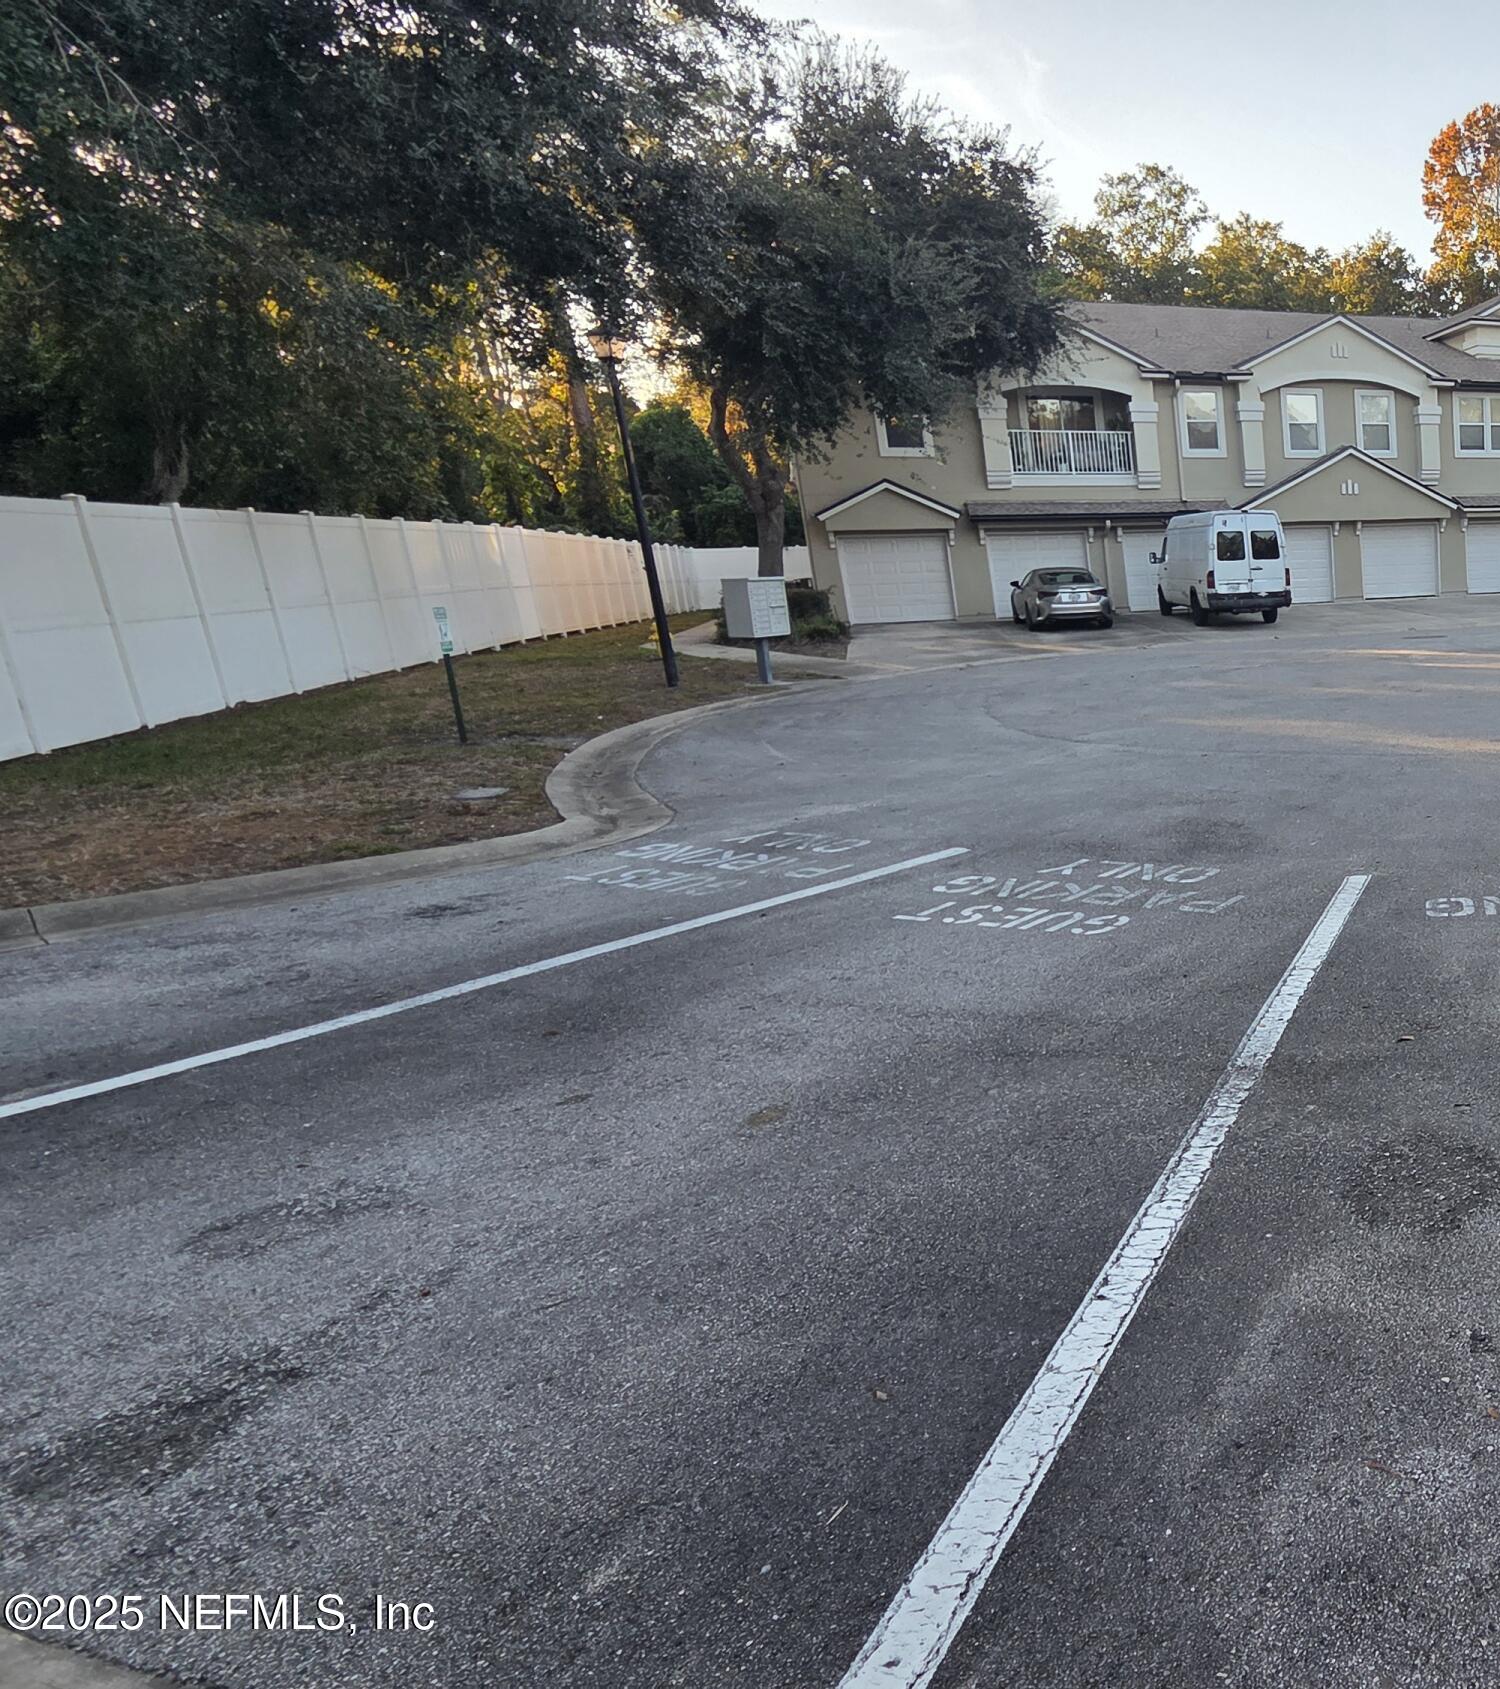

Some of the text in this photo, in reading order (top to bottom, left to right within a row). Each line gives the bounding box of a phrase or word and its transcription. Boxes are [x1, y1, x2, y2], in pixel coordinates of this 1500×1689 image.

[1037, 859, 1221, 882] ONLY
[932, 875, 1246, 913] PARKING
[892, 901, 1131, 935] GUEST
